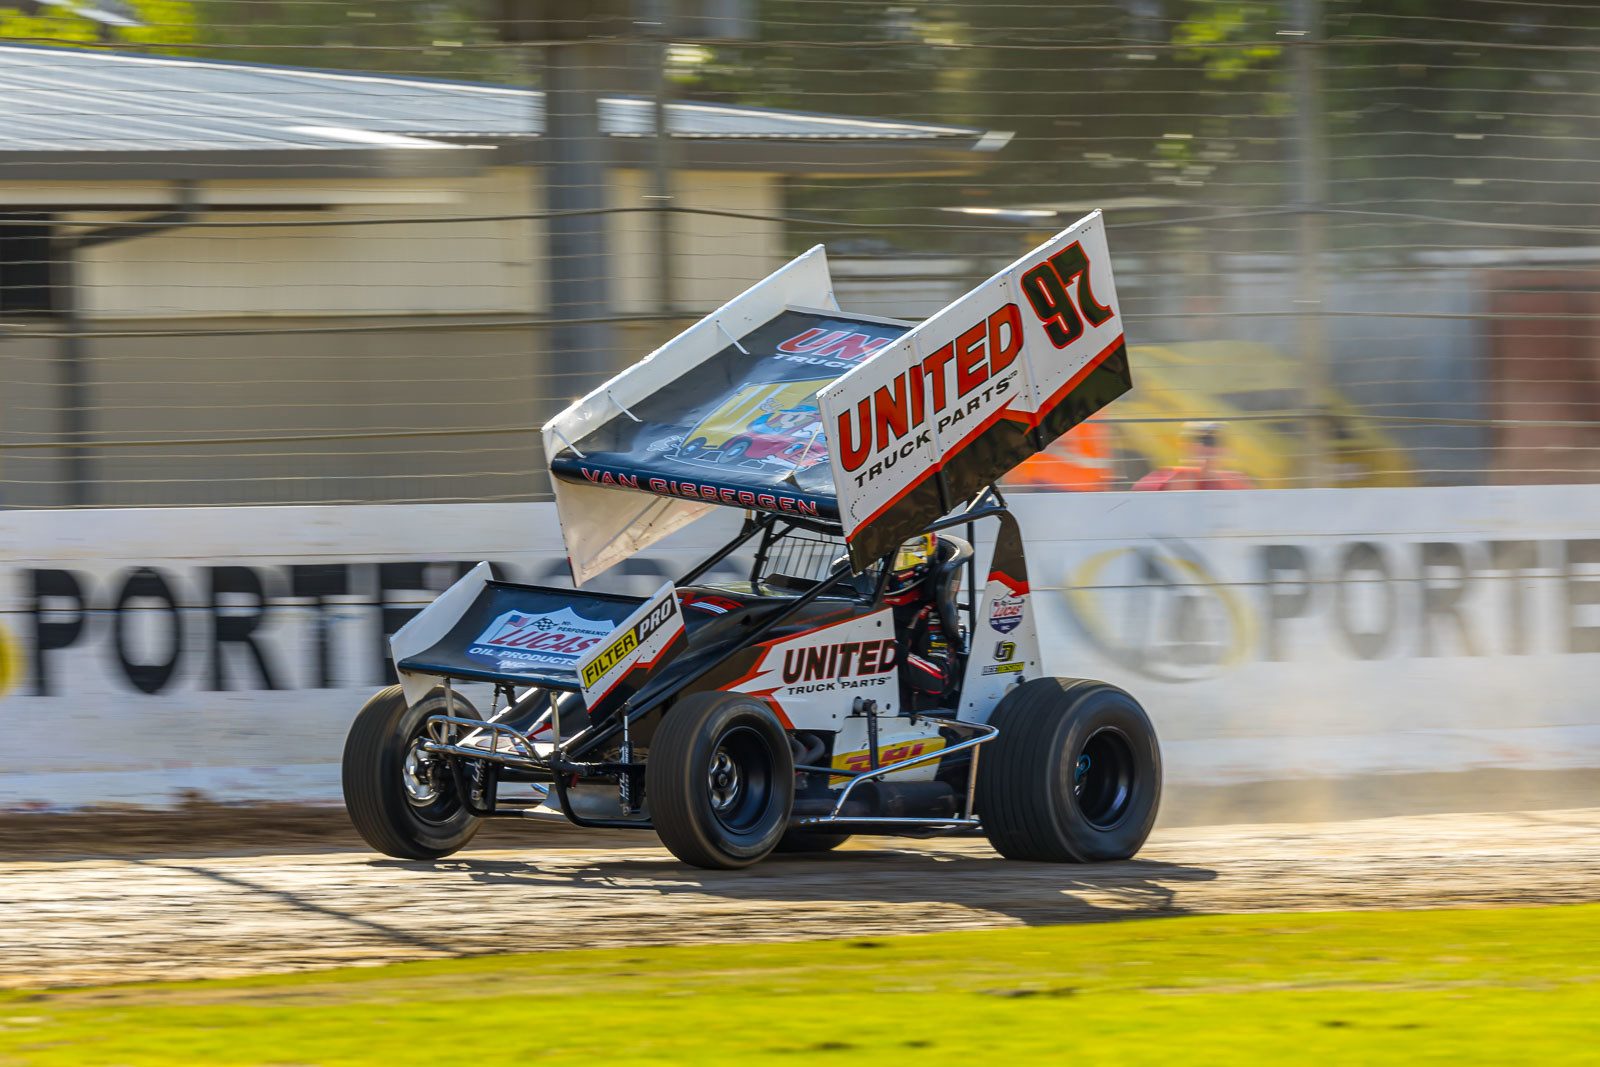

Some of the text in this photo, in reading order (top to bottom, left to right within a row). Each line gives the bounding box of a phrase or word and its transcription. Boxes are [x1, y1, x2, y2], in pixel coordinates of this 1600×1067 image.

[1021, 240, 1115, 350] 97
[838, 302, 1024, 472] UNITED
[854, 430, 931, 488] TRUCK
[937, 376, 1010, 434] PARTS
[581, 467, 820, 517] VAN GISBERGEN
[469, 647, 577, 666] OIL PRODUCTS
[488, 629, 602, 655] LUCAS
[585, 633, 636, 685] FILTER
[637, 598, 673, 641] PRO
[782, 638, 898, 685] UNITED
[787, 677, 886, 695] TRUCK PARTS
